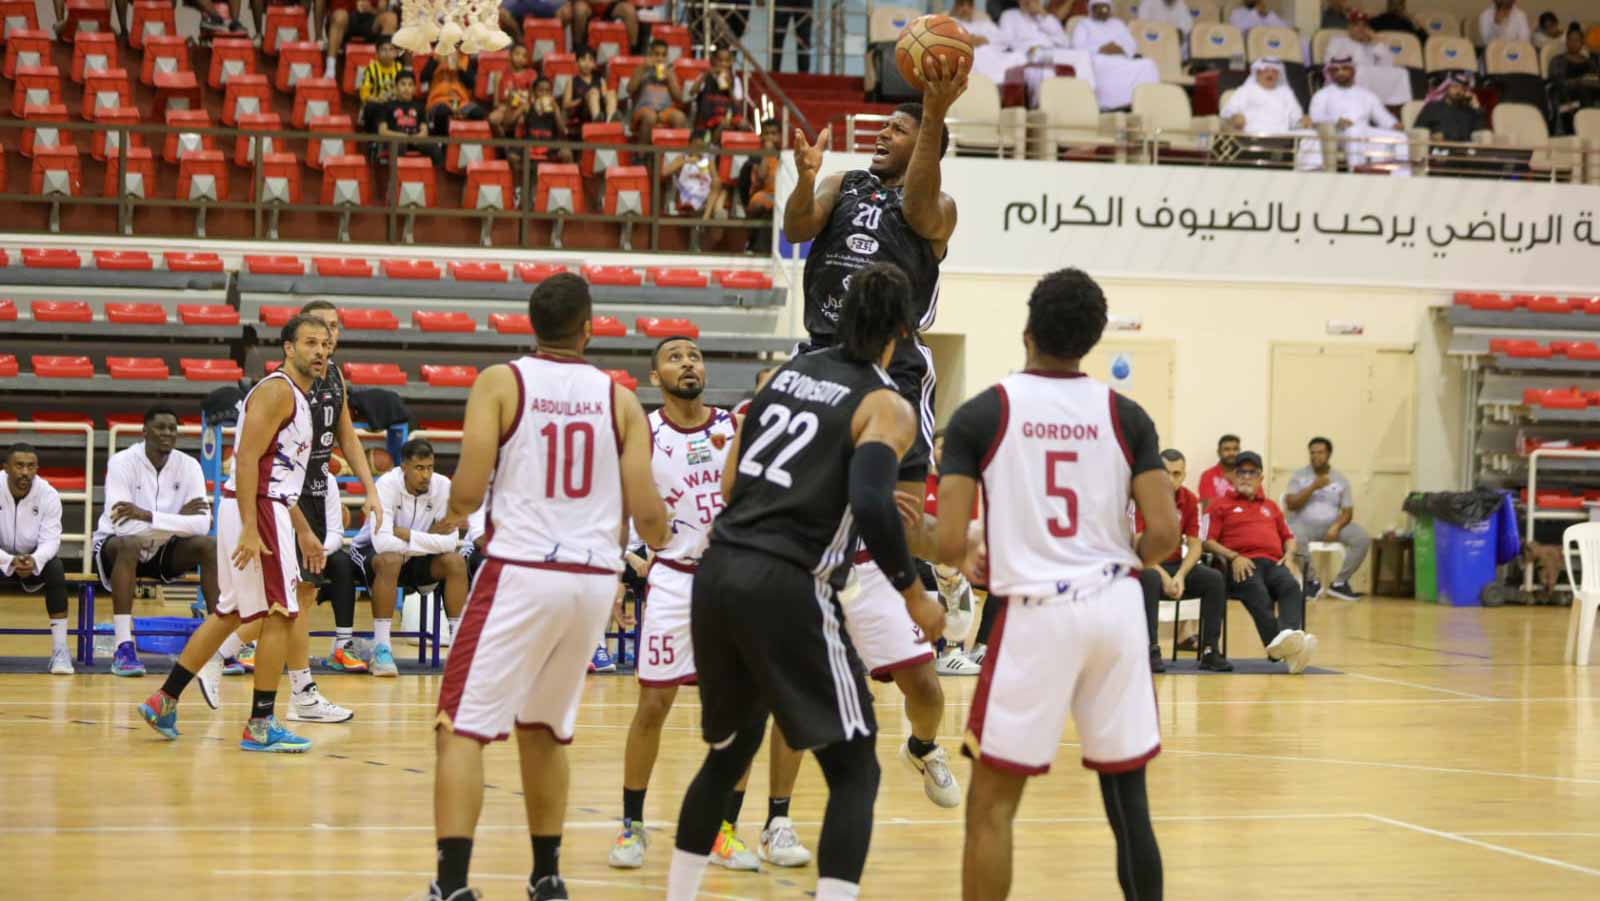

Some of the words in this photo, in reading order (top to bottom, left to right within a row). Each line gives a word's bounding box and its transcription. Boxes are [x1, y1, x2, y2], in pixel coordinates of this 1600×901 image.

[852, 202, 882, 230] 20
[1004, 194, 1123, 232] الكرام
[1136, 197, 1301, 243] بالضيوف
[1314, 212, 1415, 247] يرحب
[1427, 211, 1561, 258] الرياضي
[739, 403, 819, 489] 22
[1022, 421, 1099, 440] GORDON
[541, 421, 594, 499] 10
[684, 469, 721, 488] WAH
[1045, 450, 1079, 539] 5
[648, 634, 675, 666] 55
